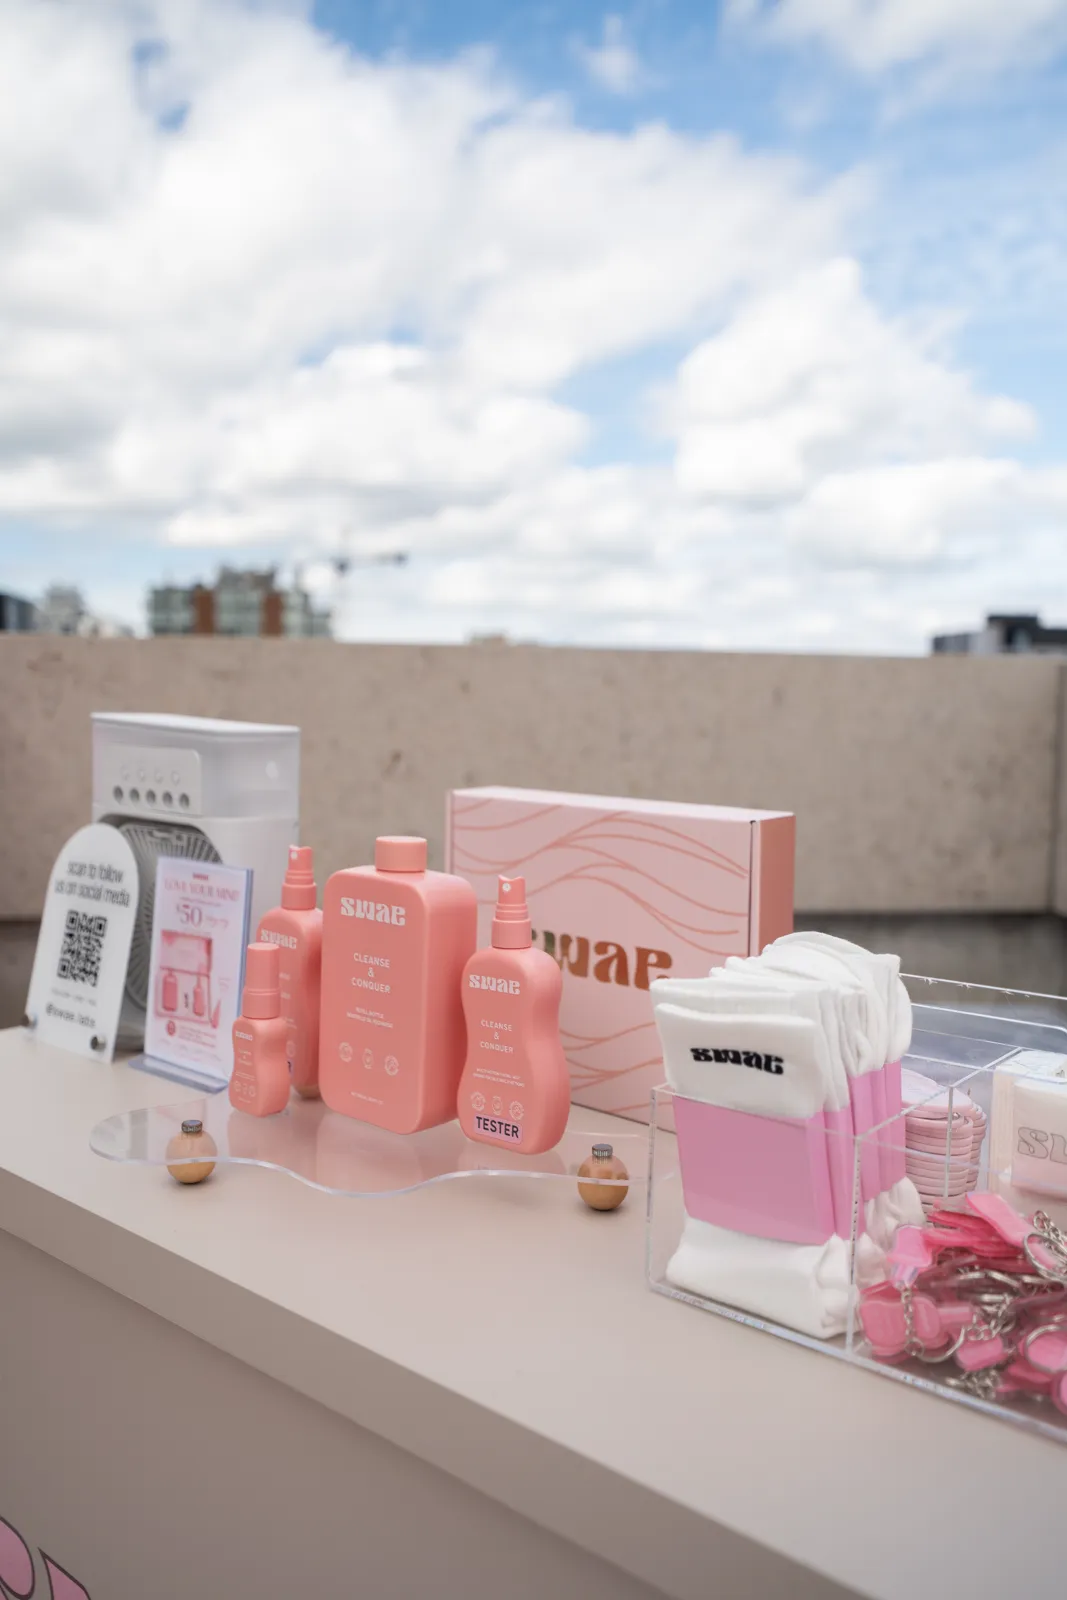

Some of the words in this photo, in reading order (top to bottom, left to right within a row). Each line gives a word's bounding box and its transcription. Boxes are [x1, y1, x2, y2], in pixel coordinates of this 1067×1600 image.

[340, 896, 406, 927] swae
[353, 952, 390, 968] CLEANSE
[531, 928, 672, 992] wae
[367, 966, 375, 978] &
[351, 977, 391, 993] CONQUER
[468, 974, 521, 995] swae
[480, 1019, 512, 1032] CLEANSE
[493, 1031, 500, 1040] &
[480, 1041, 514, 1054] CONQUER
[476, 1116, 519, 1138] TESTER
